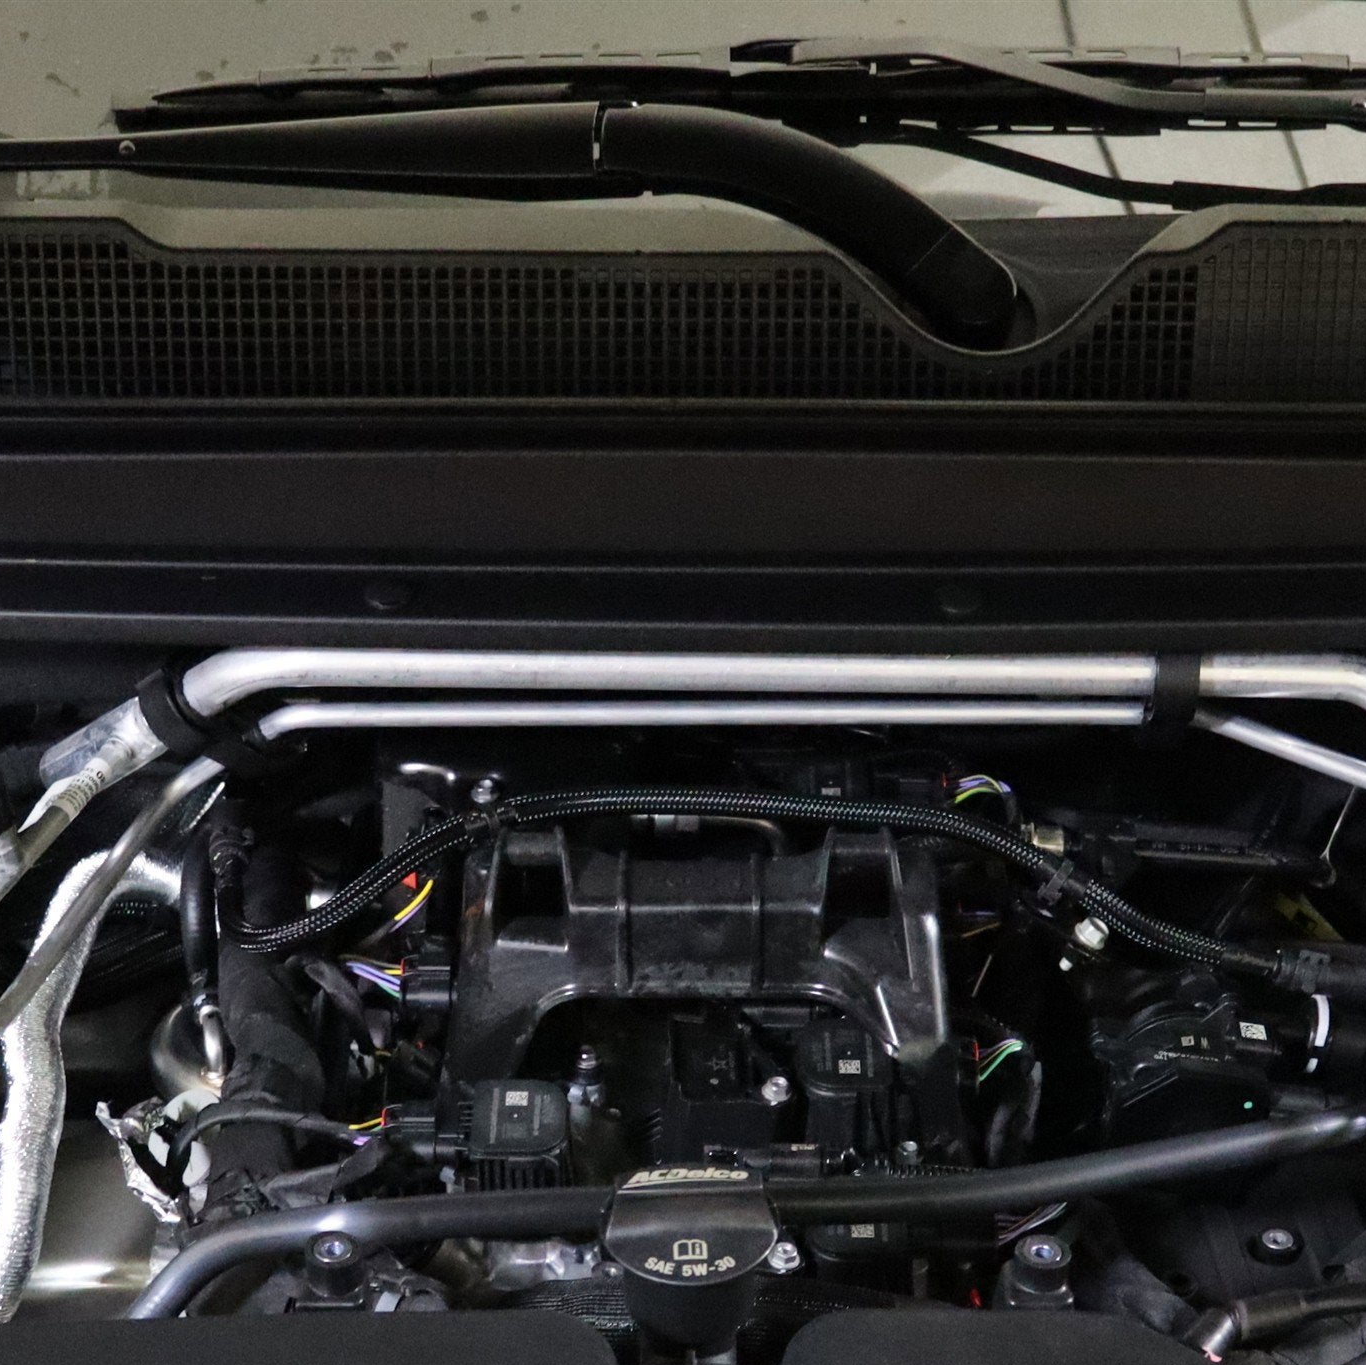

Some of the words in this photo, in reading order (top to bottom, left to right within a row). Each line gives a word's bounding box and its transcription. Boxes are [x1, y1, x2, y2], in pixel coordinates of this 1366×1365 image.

[627, 1167, 750, 1186] ACDelco
[644, 1256, 675, 1276] SAE
[681, 1255, 736, 1278] 5W-30
